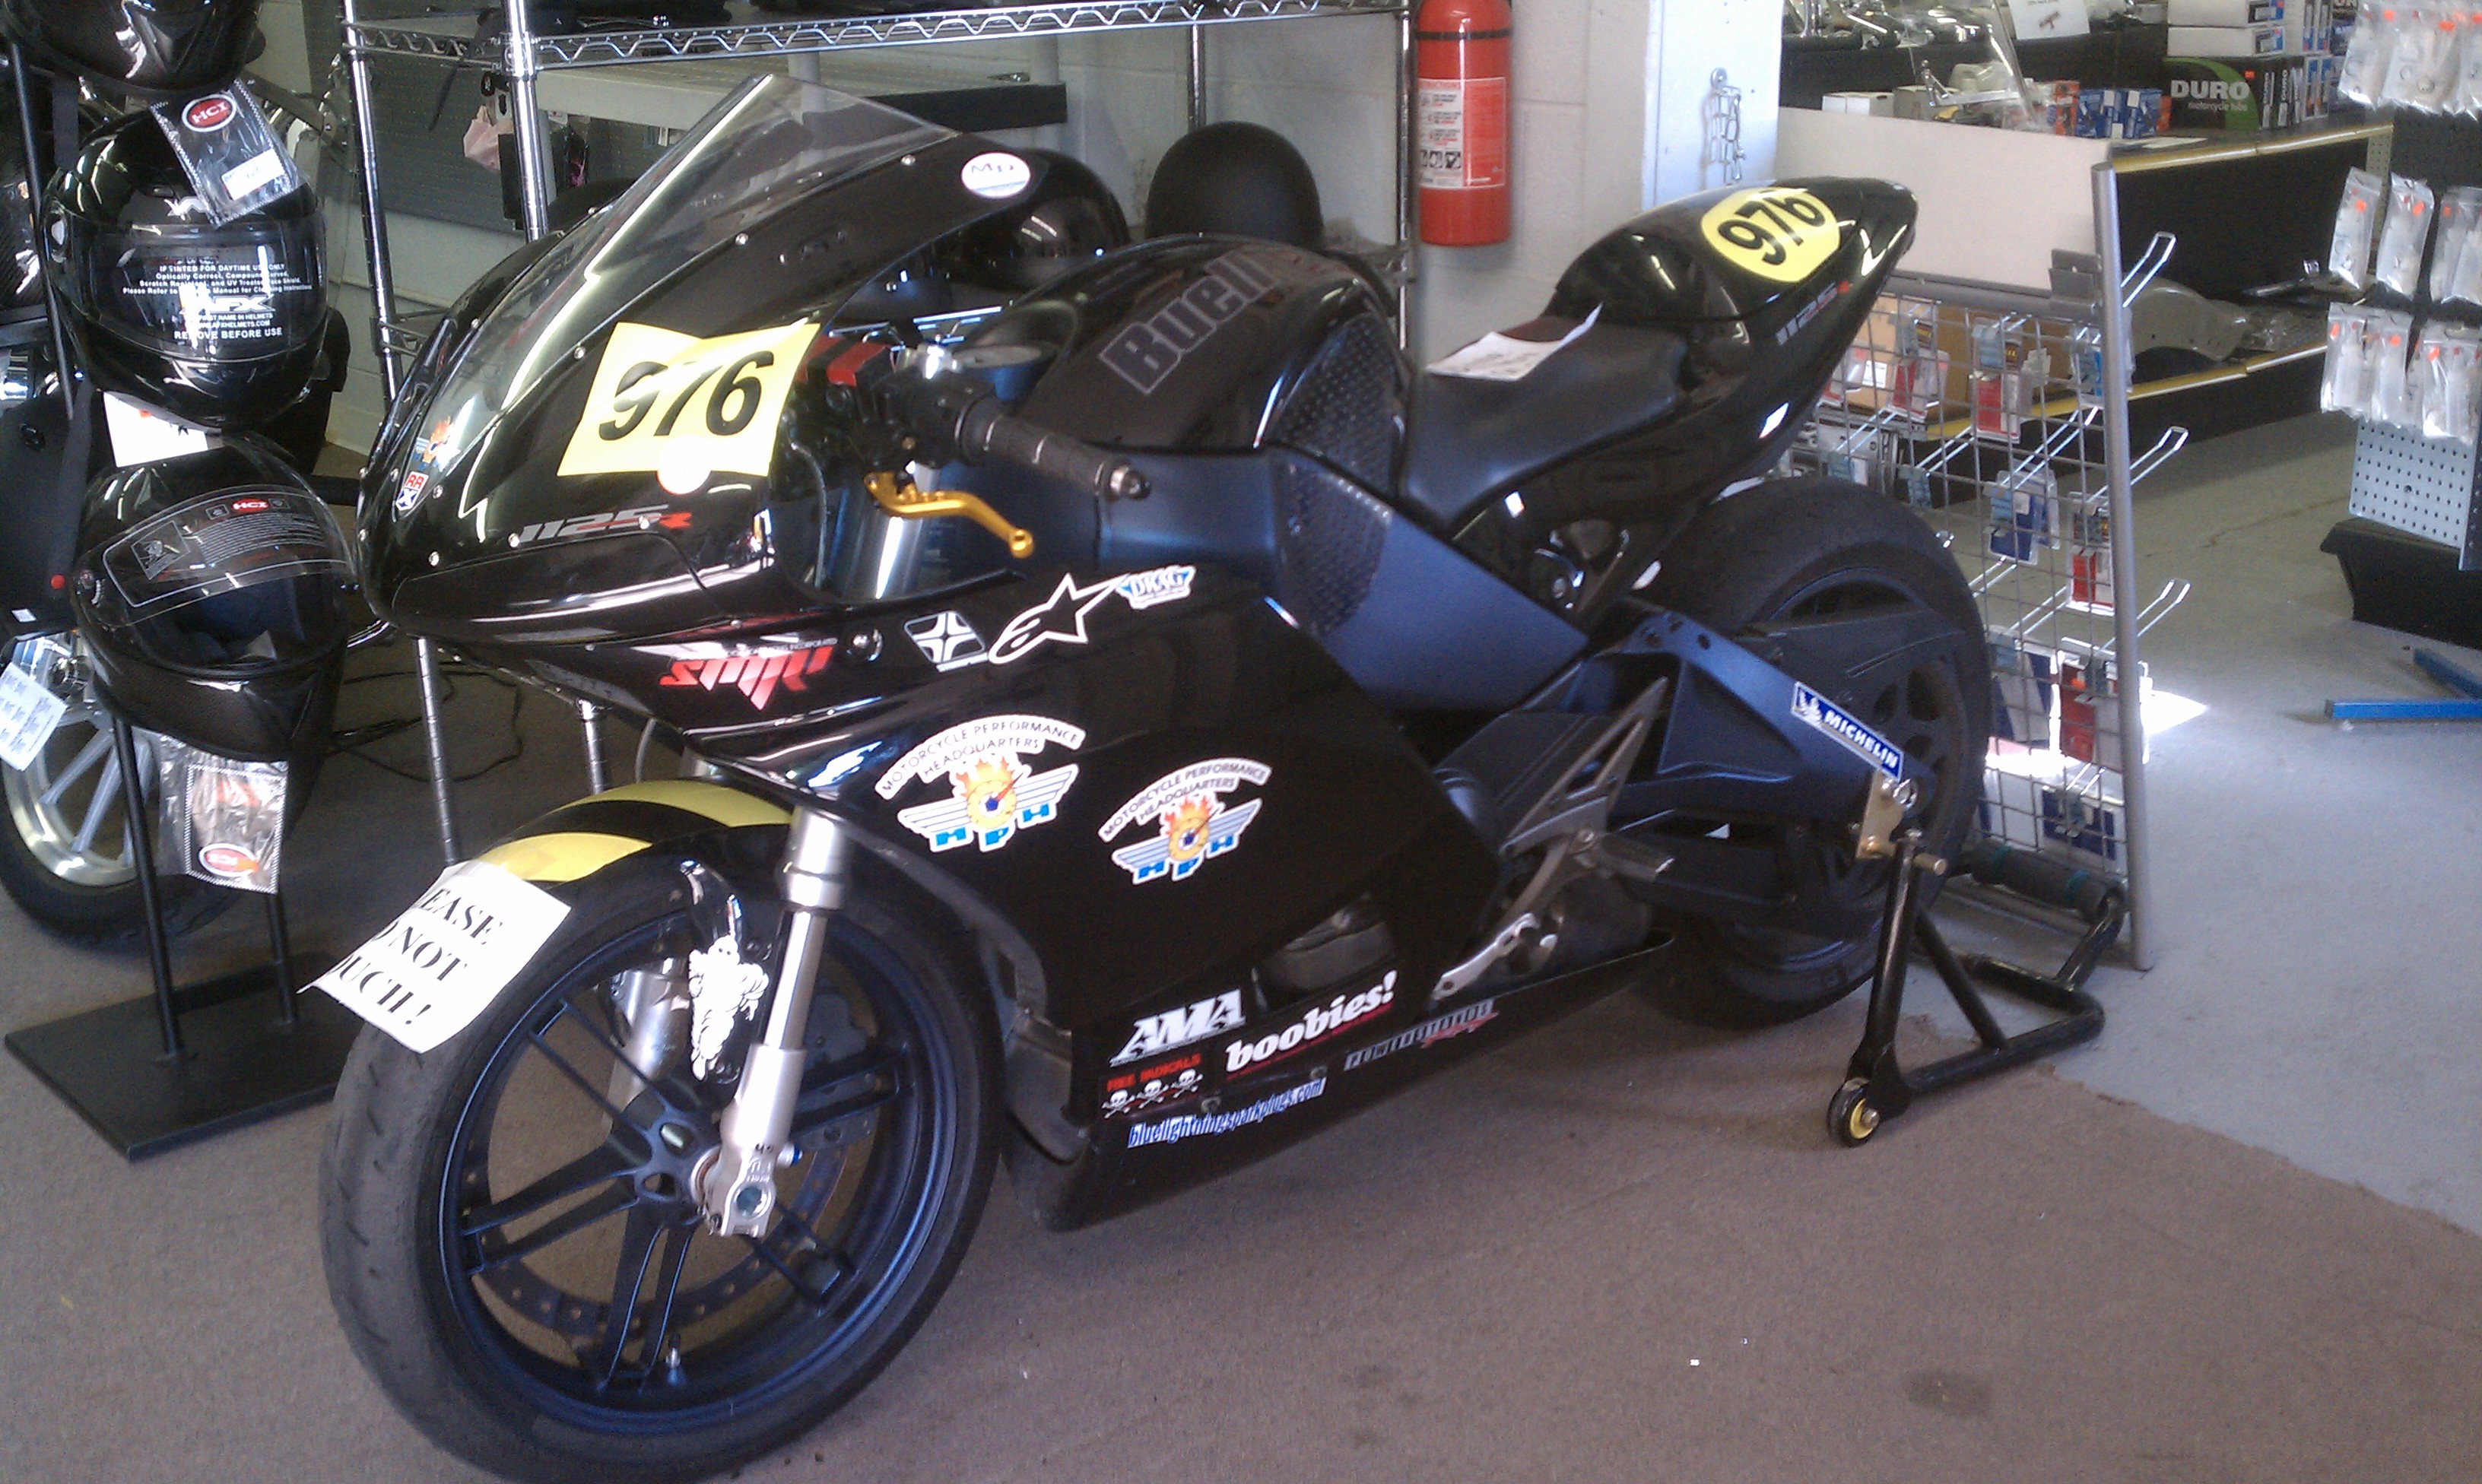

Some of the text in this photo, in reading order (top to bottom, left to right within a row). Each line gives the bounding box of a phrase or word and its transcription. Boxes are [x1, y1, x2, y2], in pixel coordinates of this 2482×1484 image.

[192, 101, 228, 124] HCI
[2170, 79, 2251, 100] DURO
[1718, 188, 1827, 266] 976
[174, 327, 283, 340] REOVE BEFORE USE
[1099, 250, 1281, 395] Buell
[598, 350, 775, 441] 976
[231, 501, 268, 510] HCI
[881, 721, 1078, 792] MOTORCYCLE PERFORMANCE
[923, 736, 1039, 777] HEADQUARTERS
[1824, 709, 1900, 769] MICHELIN
[1103, 762, 1267, 836] MOTORCYCLE PERFORMANCE
[1139, 776, 1236, 820] HEADQUARTERS
[389, 925, 468, 981] NOT
[1109, 988, 1248, 1066] AMA
[1225, 969, 1398, 1073] boobies!
